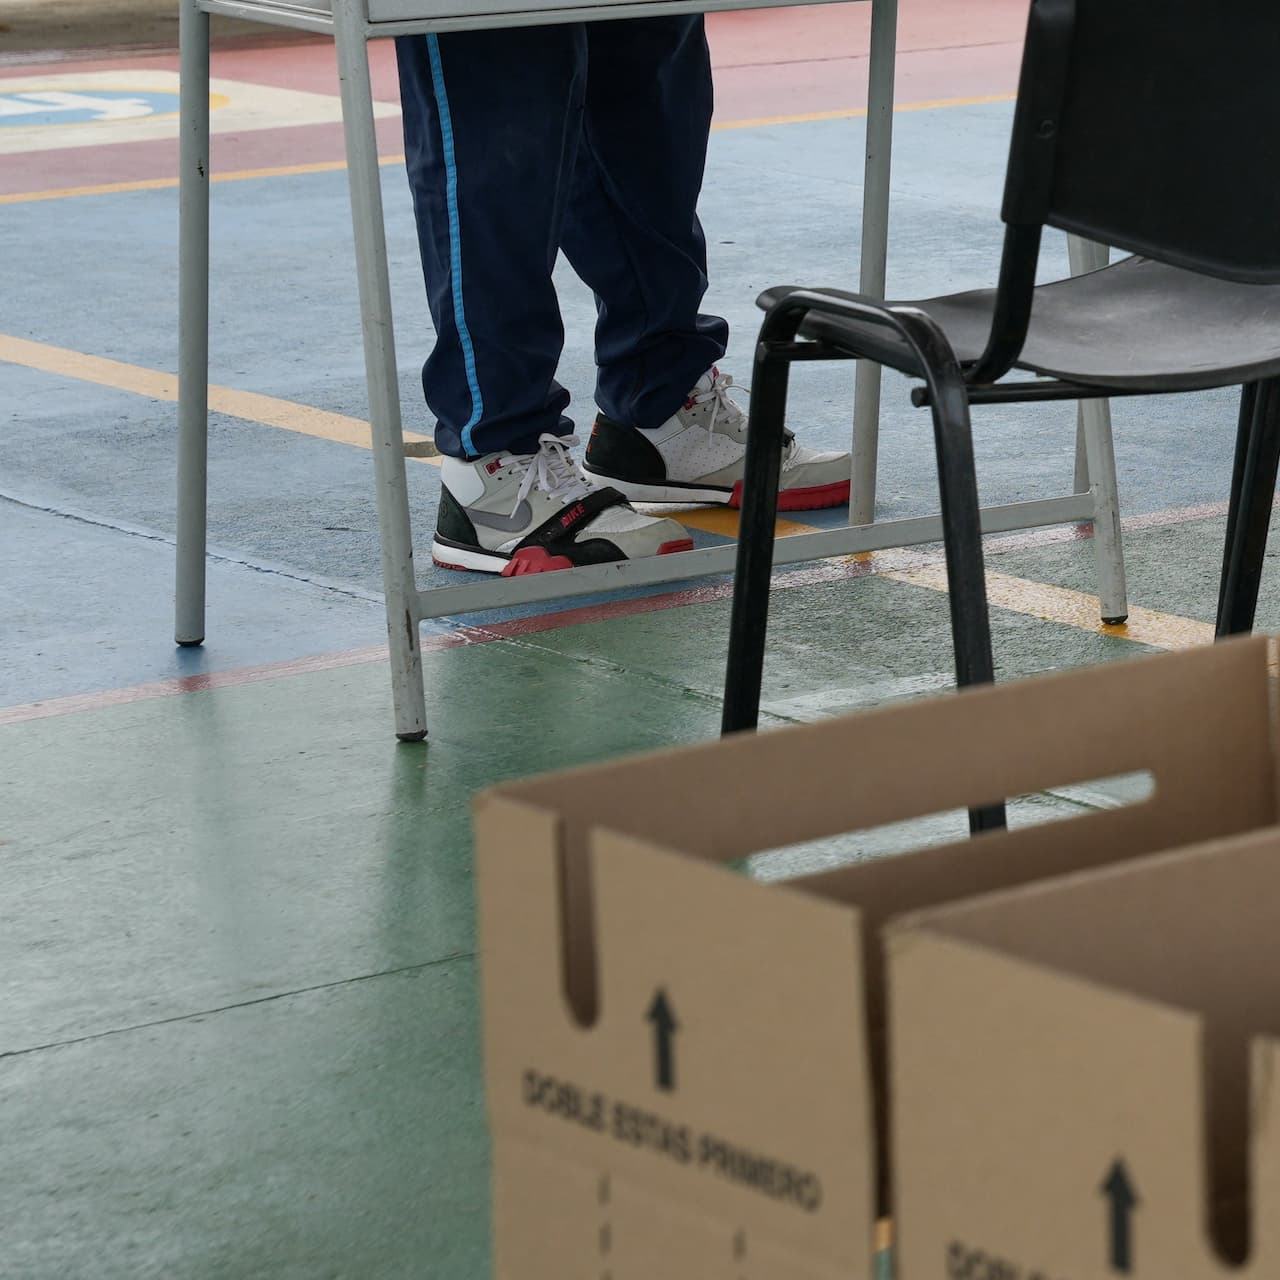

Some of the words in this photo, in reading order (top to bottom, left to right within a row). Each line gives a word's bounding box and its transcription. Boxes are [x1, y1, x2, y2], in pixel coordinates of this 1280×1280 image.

[523, 1068, 605, 1134] DOBLE
[612, 1101, 693, 1165] ESTAS
[699, 1132, 823, 1214] PRIMERO
